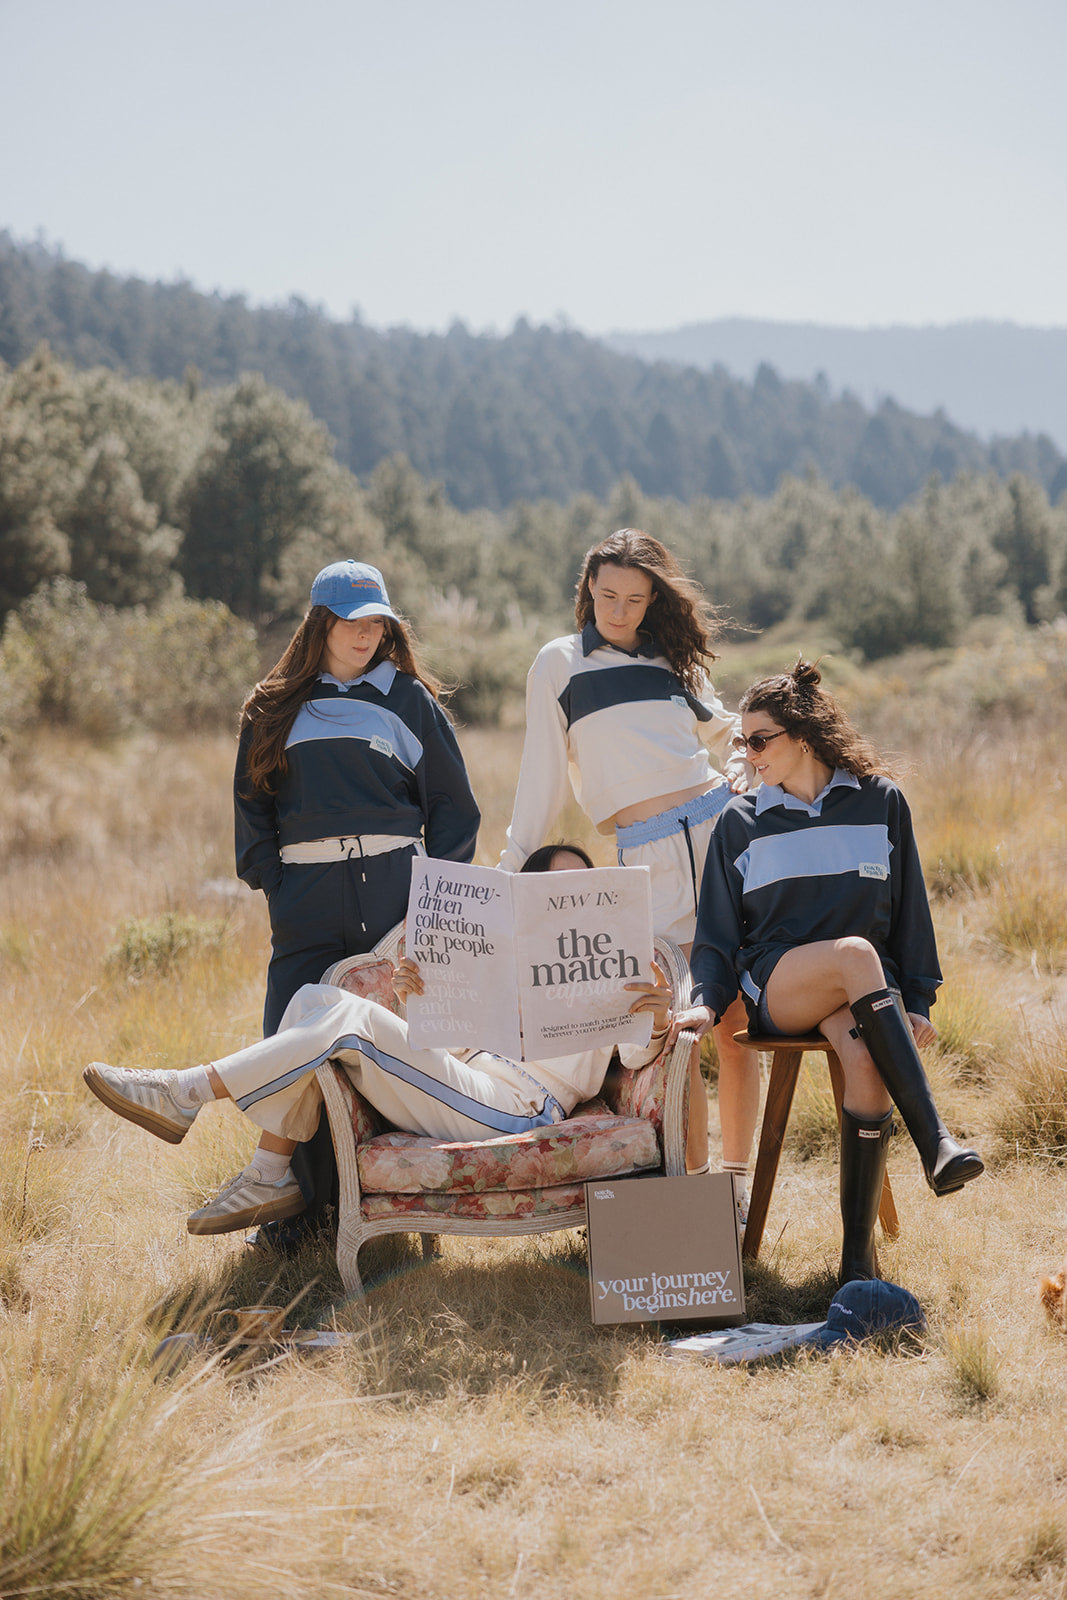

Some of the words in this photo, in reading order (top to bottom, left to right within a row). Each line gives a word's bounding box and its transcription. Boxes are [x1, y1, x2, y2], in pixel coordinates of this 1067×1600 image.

[420, 873, 430, 891] A
[434, 876, 501, 905] journey-
[418, 893, 462, 915] driven
[547, 893, 590, 911] NEW
[596, 890, 618, 906] IN:
[415, 913, 485, 937] collection
[414, 929, 438, 946] for
[443, 936, 495, 957] people
[556, 928, 612, 960] the
[414, 949, 451, 965] who
[530, 949, 641, 987] match
[423, 983, 483, 1004] xplore,
[419, 999, 452, 1015] and
[541, 1024, 569, 1033] designed
[580, 1020, 600, 1028] match
[601, 1016, 618, 1025] your
[542, 1030, 573, 1039] wherever
[575, 1026, 597, 1036] you're
[598, 1023, 618, 1032] going
[598, 1277, 648, 1300] your
[651, 1270, 731, 1296] journey
